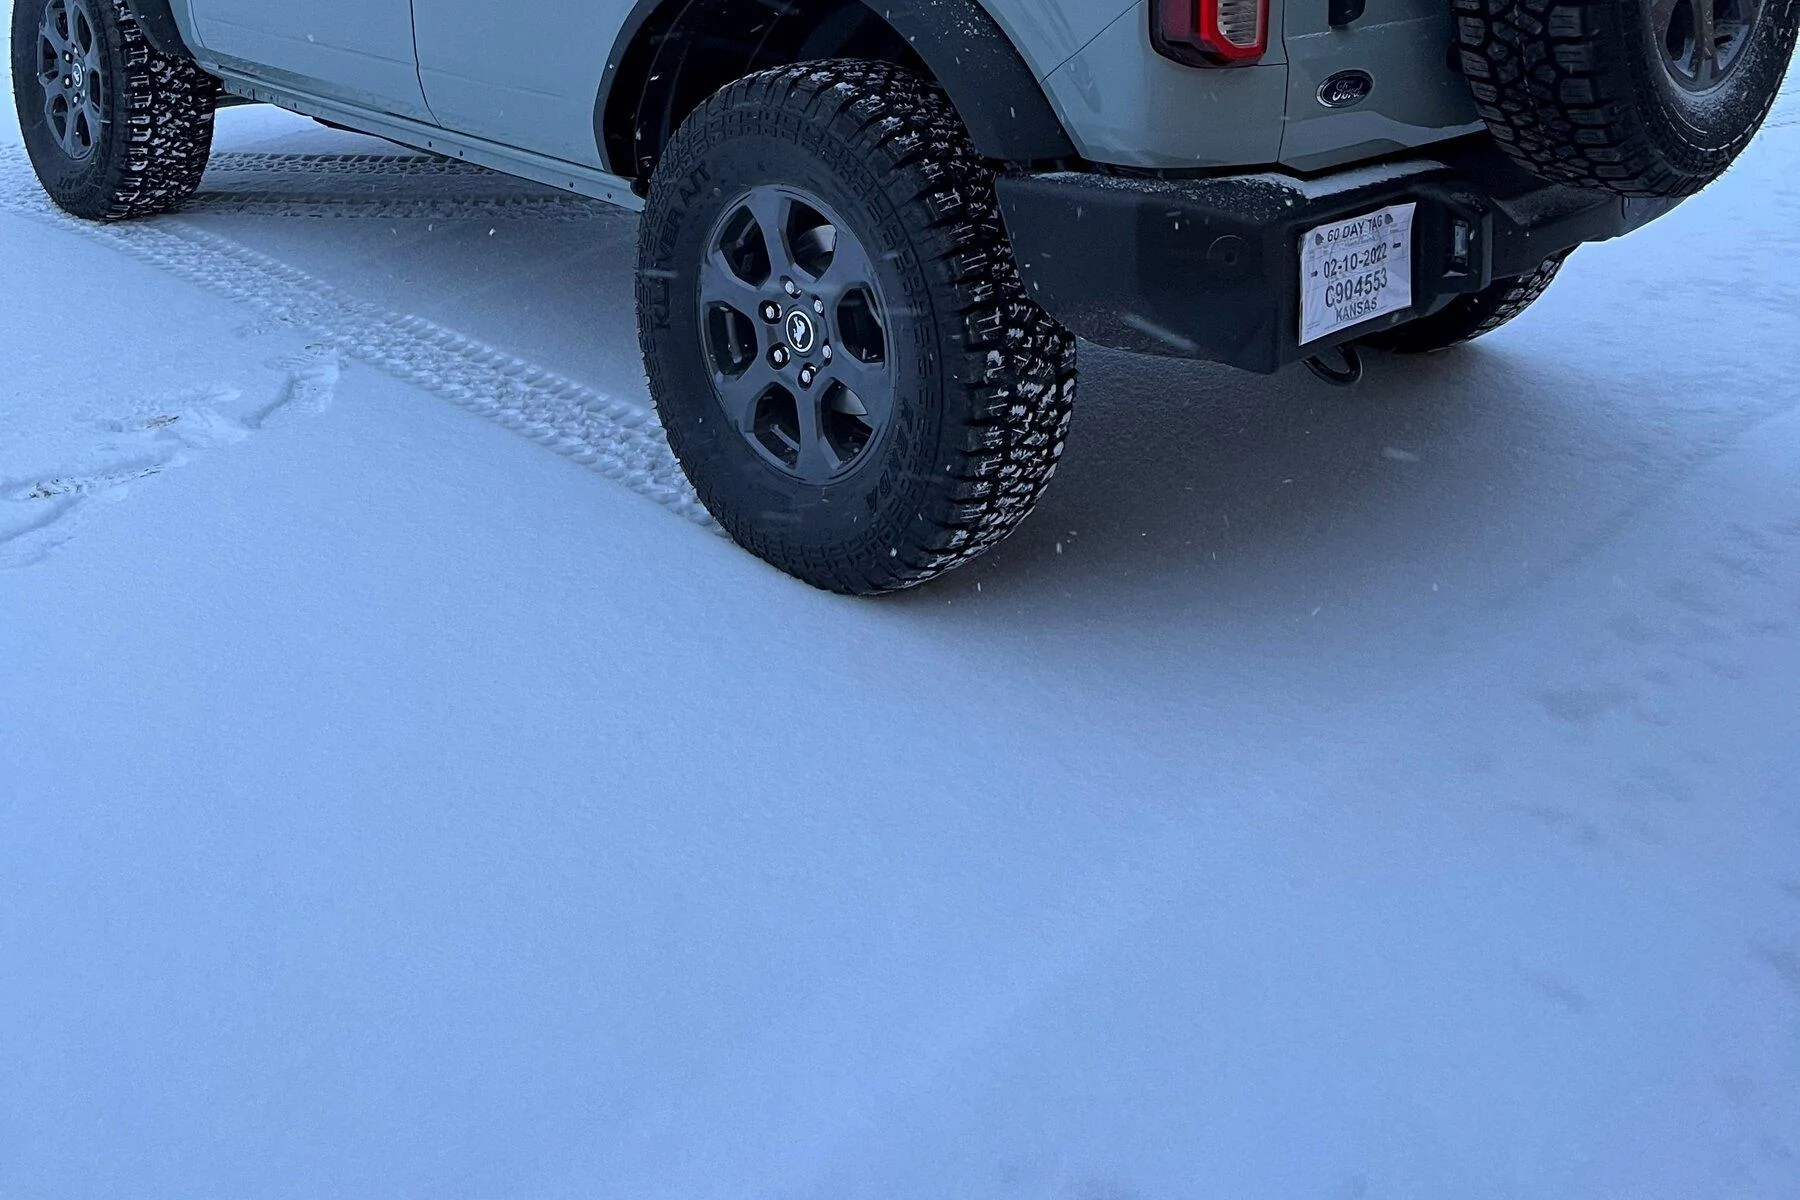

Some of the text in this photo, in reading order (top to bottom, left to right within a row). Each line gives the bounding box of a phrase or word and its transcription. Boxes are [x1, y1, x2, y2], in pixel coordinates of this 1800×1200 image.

[1327, 214, 1383, 243] 60 DAY TAG
[1323, 242, 1387, 279] 02-10-2022
[1325, 267, 1388, 308] C904553
[1335, 297, 1378, 322] KANSAS
